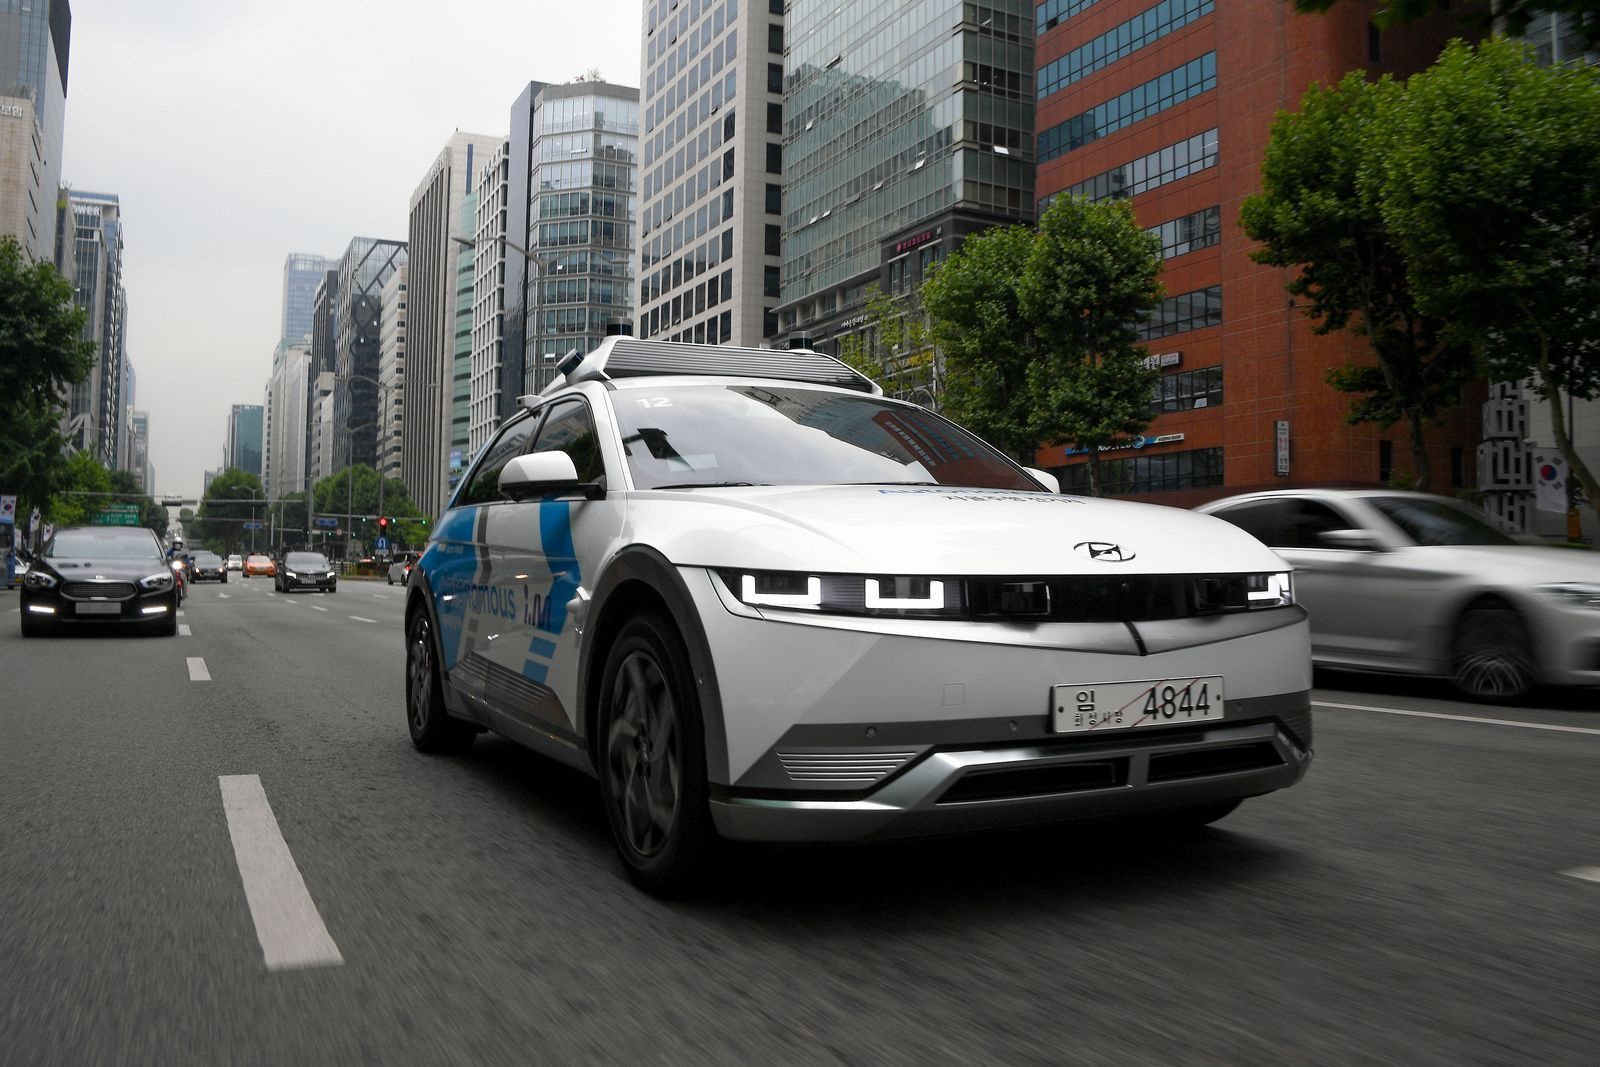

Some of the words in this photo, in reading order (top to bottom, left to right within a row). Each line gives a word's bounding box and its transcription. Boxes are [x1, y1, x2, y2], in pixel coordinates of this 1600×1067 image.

[636, 398, 672, 408] 12
[1076, 690, 1095, 712] 임
[1143, 683, 1210, 720] 4844
